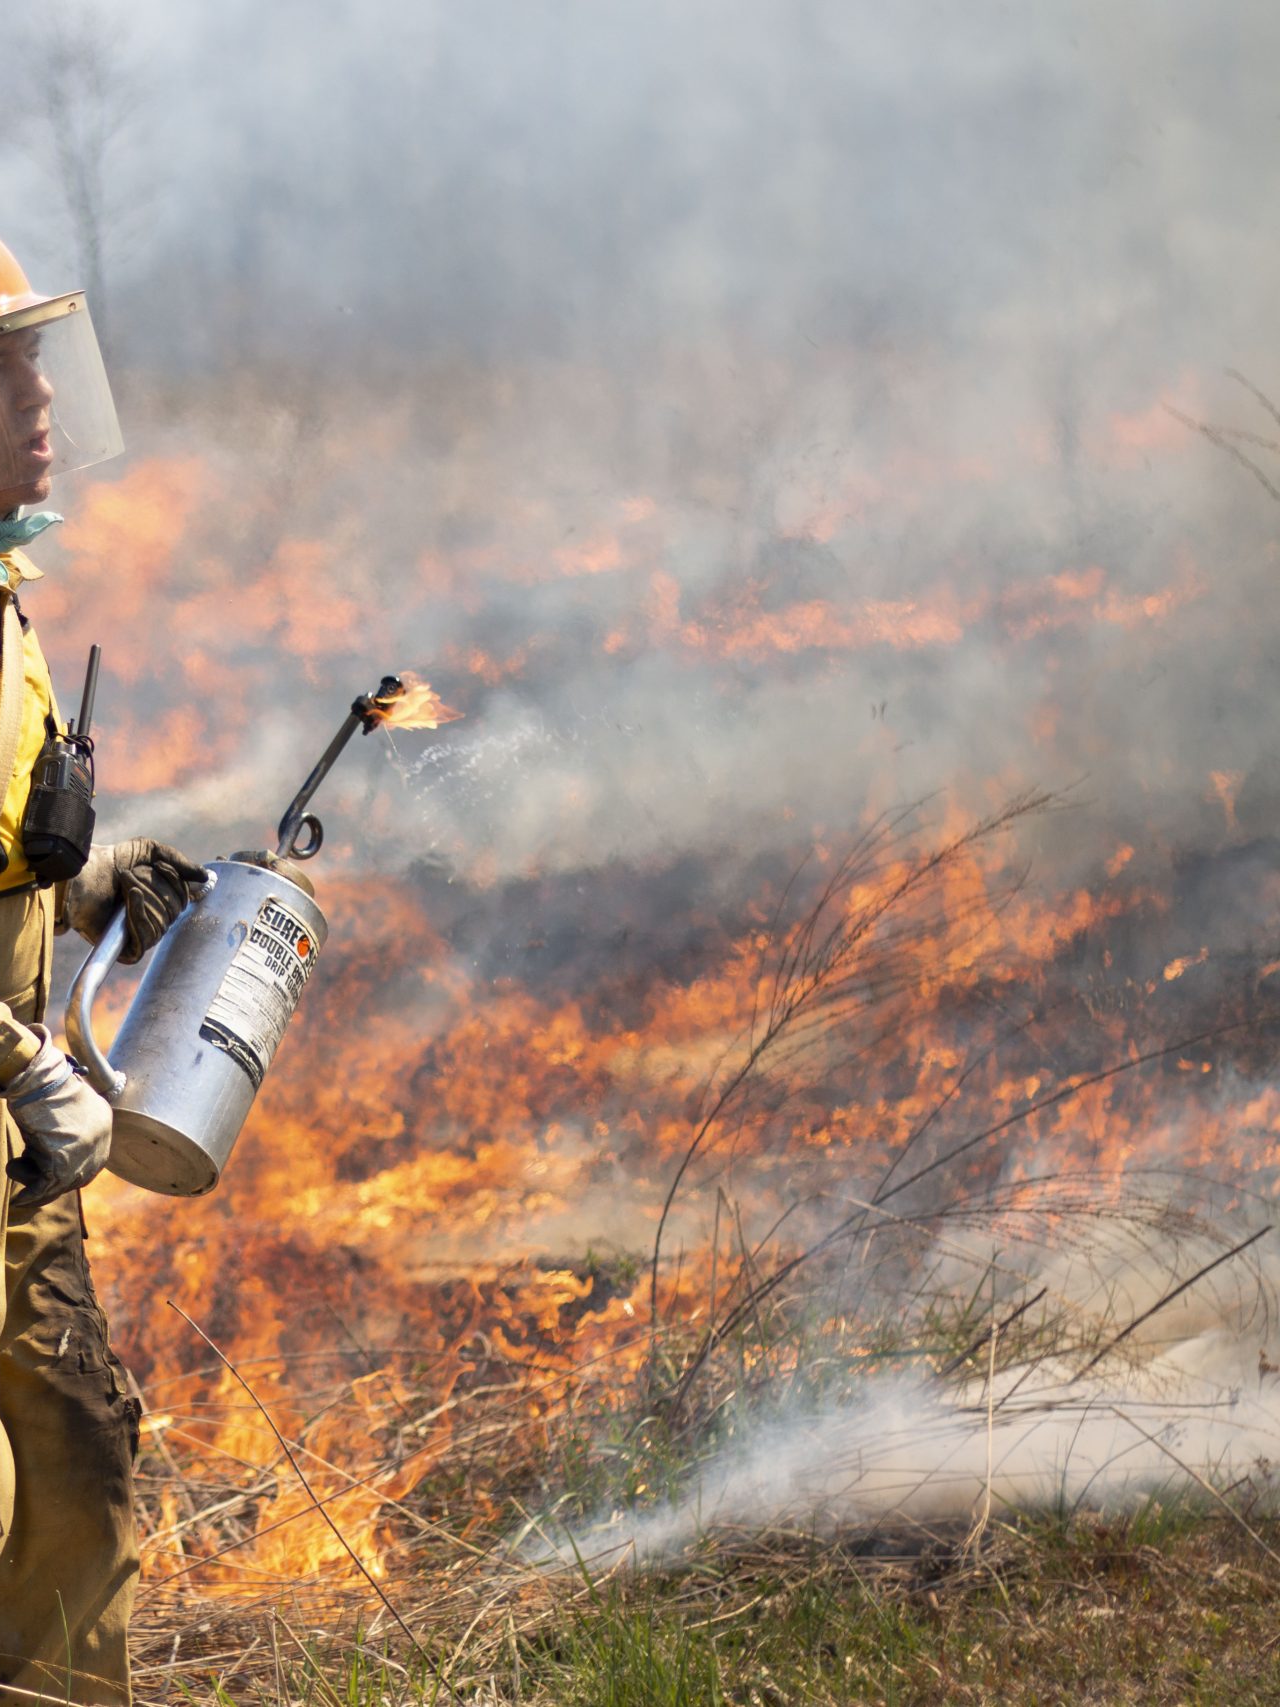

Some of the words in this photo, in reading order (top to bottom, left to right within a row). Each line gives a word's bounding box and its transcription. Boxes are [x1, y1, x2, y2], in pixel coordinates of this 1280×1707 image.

[260, 906, 303, 947] SURE
[250, 927, 294, 970] DOUBLE
[264, 955, 286, 978] DRIP
